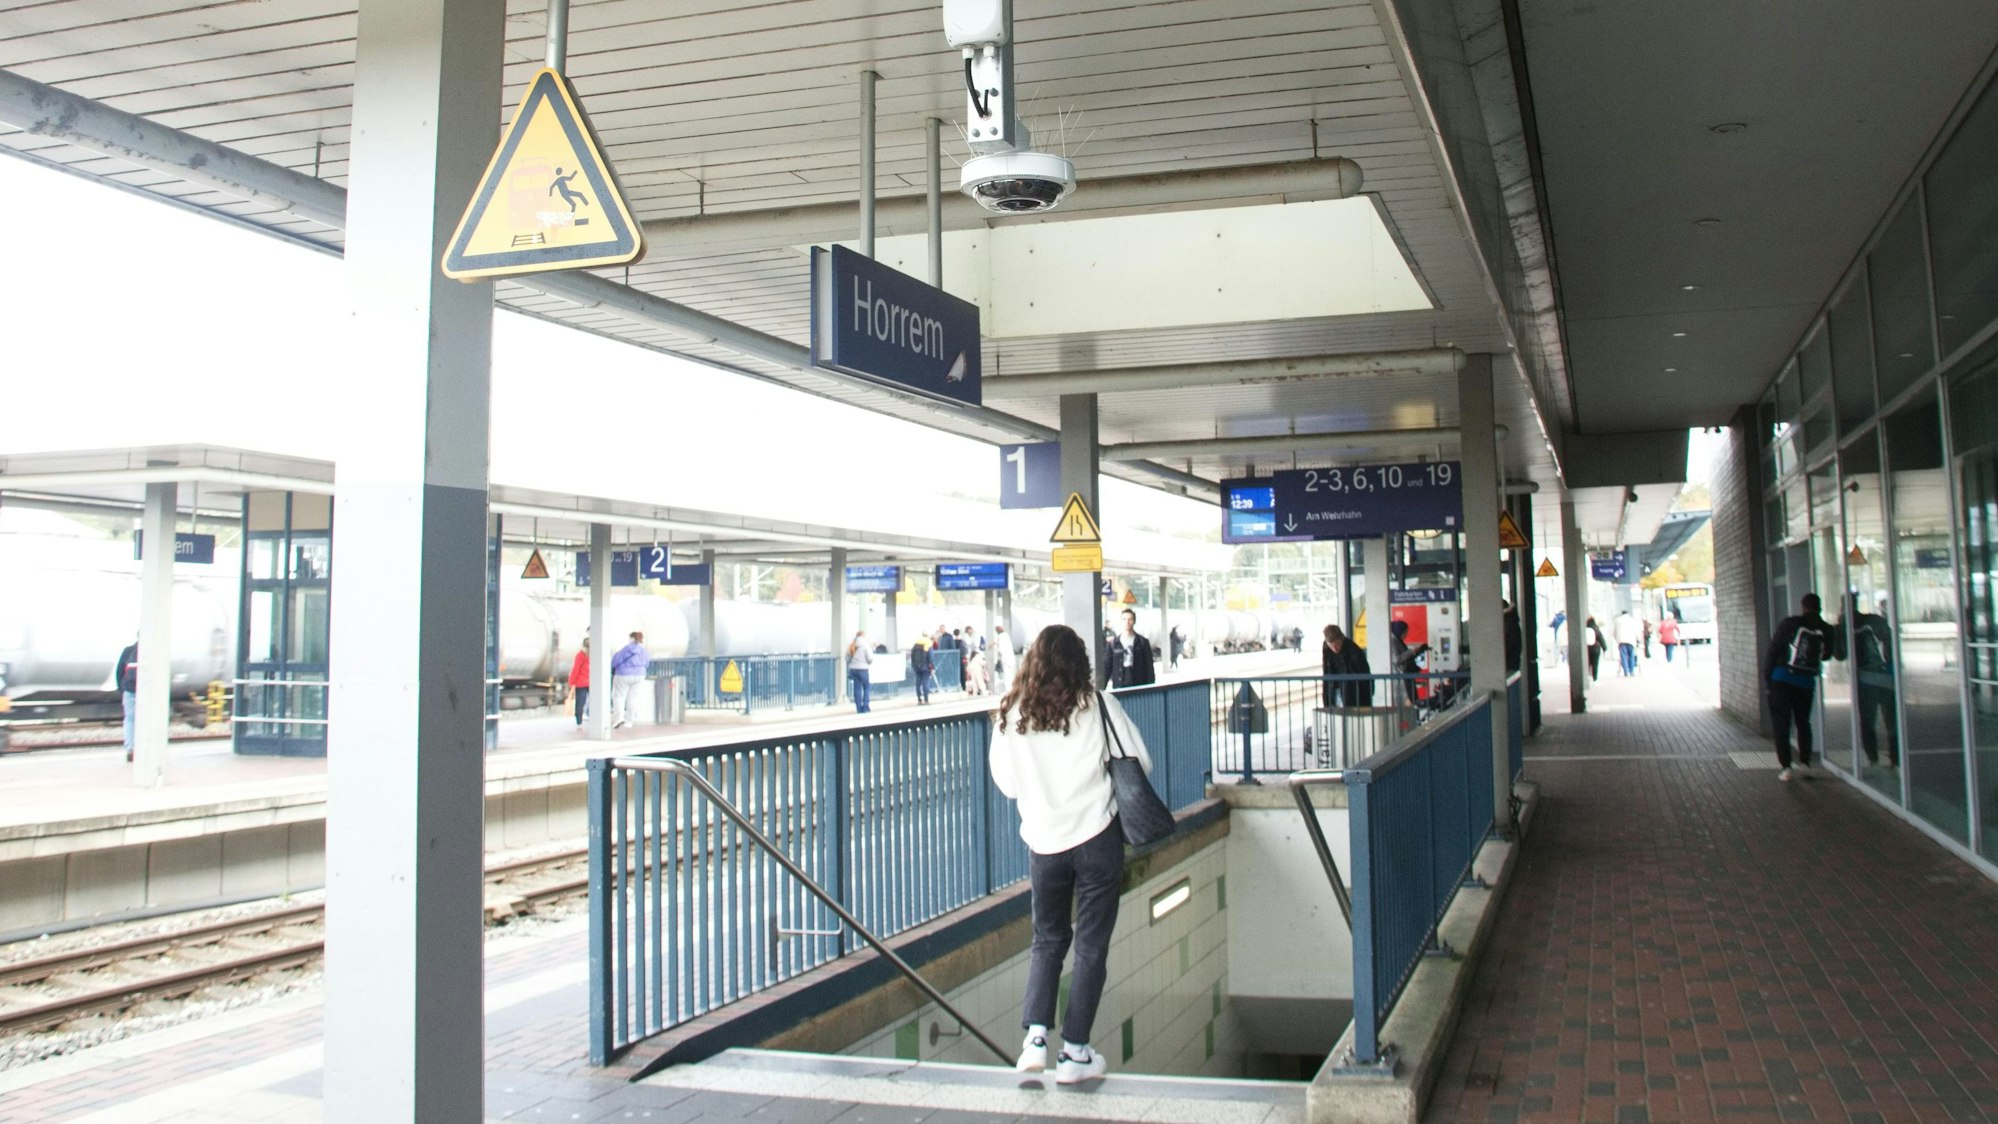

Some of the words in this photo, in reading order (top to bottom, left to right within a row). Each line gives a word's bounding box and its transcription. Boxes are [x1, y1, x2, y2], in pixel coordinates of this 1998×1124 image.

[853, 274, 944, 361] Horrem
[1006, 445, 1026, 494] 1
[1407, 478, 1424, 488] und
[1426, 463, 1452, 486] 19
[1305, 512, 1320, 521] Am
[1321, 510, 1362, 521] Wehrhahn
[650, 547, 665, 573] 2
[1101, 580, 1111, 593] 2
